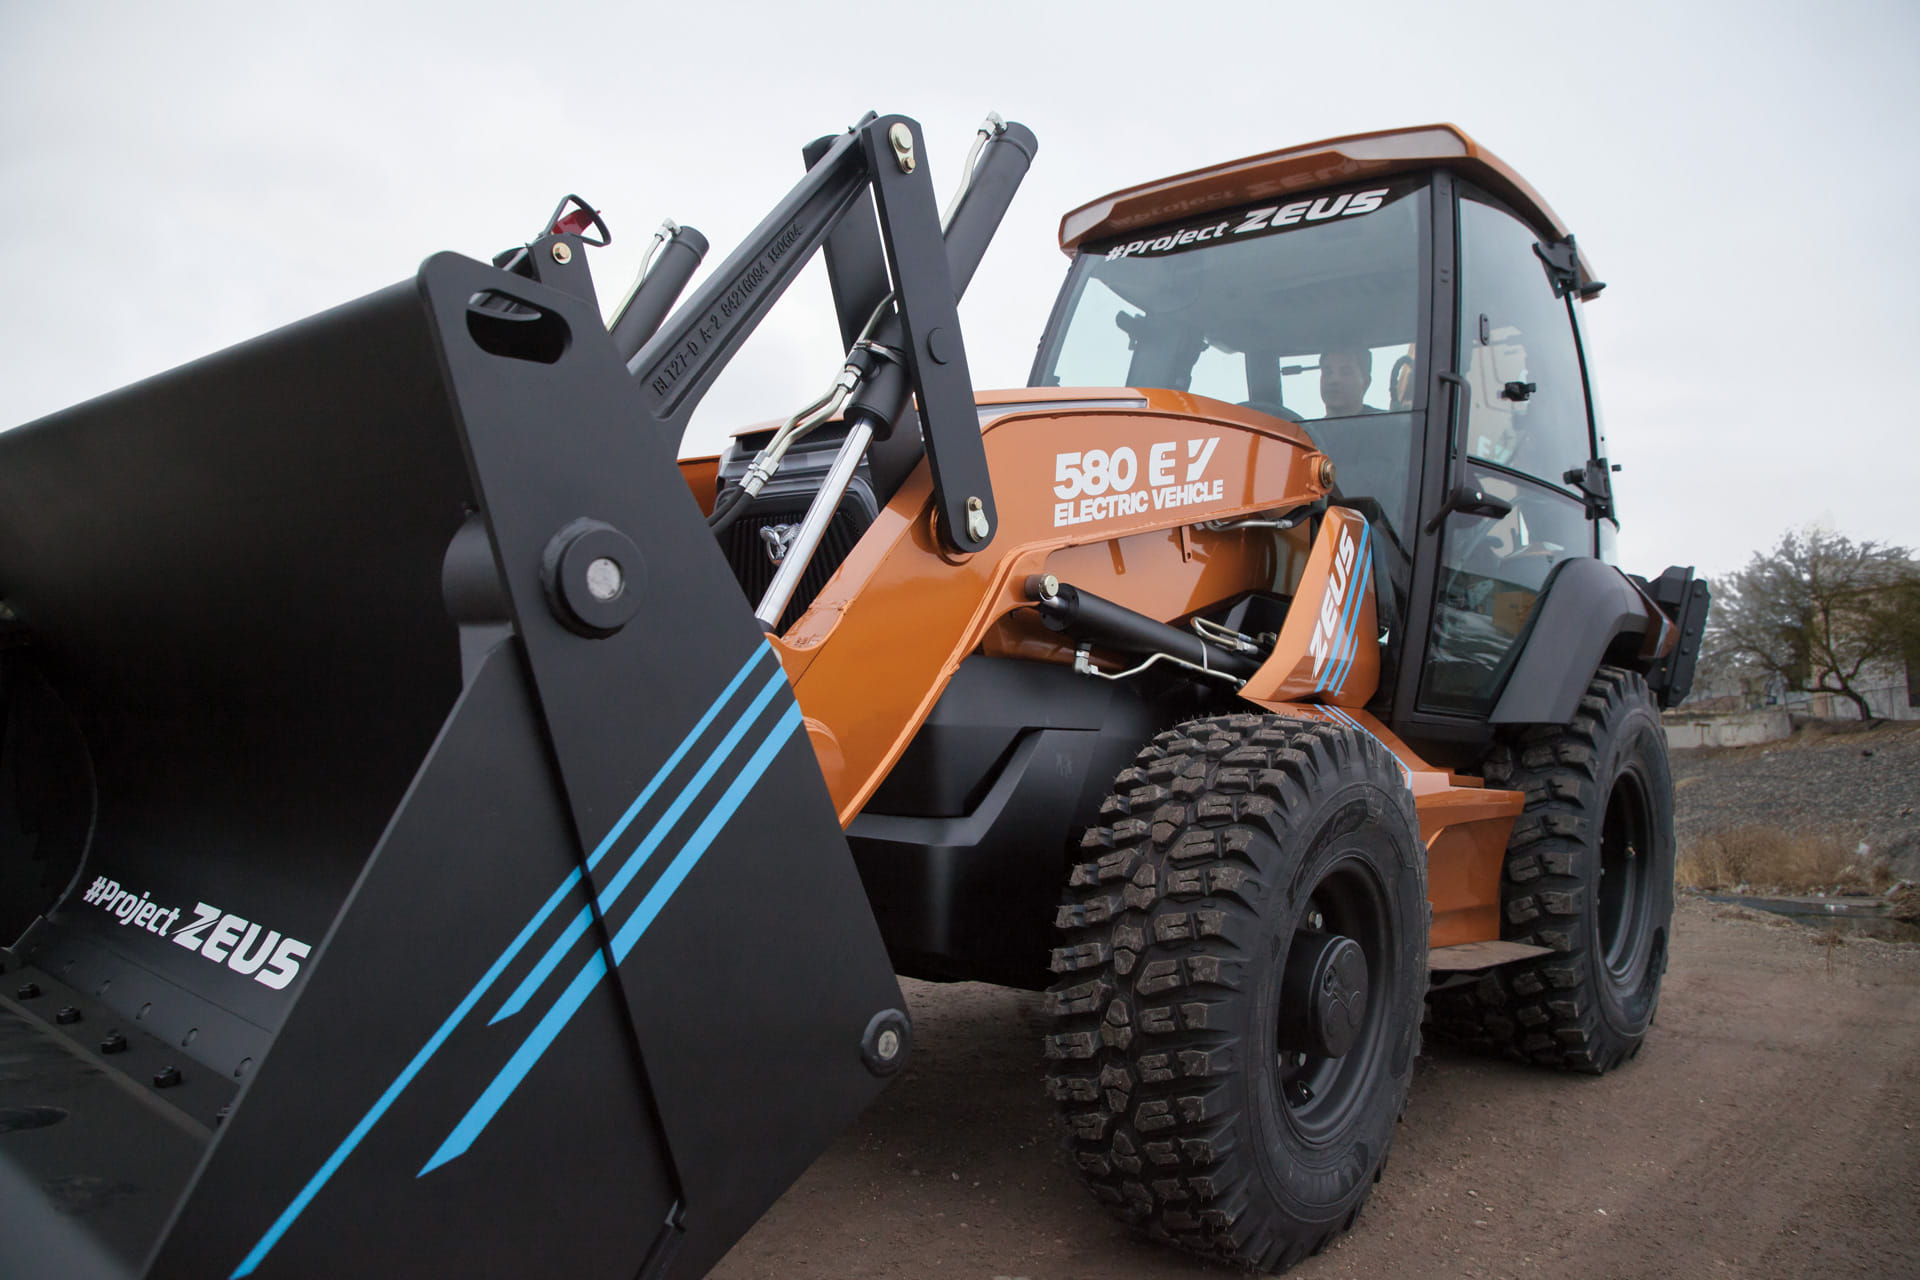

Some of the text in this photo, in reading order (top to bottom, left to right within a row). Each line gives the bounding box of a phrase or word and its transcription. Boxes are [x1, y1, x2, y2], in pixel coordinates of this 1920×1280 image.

[1105, 220, 1230, 262] #Project
[1231, 188, 1390, 234] ZEUS
[1053, 446, 1138, 500] 580
[1053, 479, 1224, 528] ELECTRIC VEHICLE
[1309, 523, 1355, 680] ZEUS
[82, 875, 312, 990] #Project ZEUS
